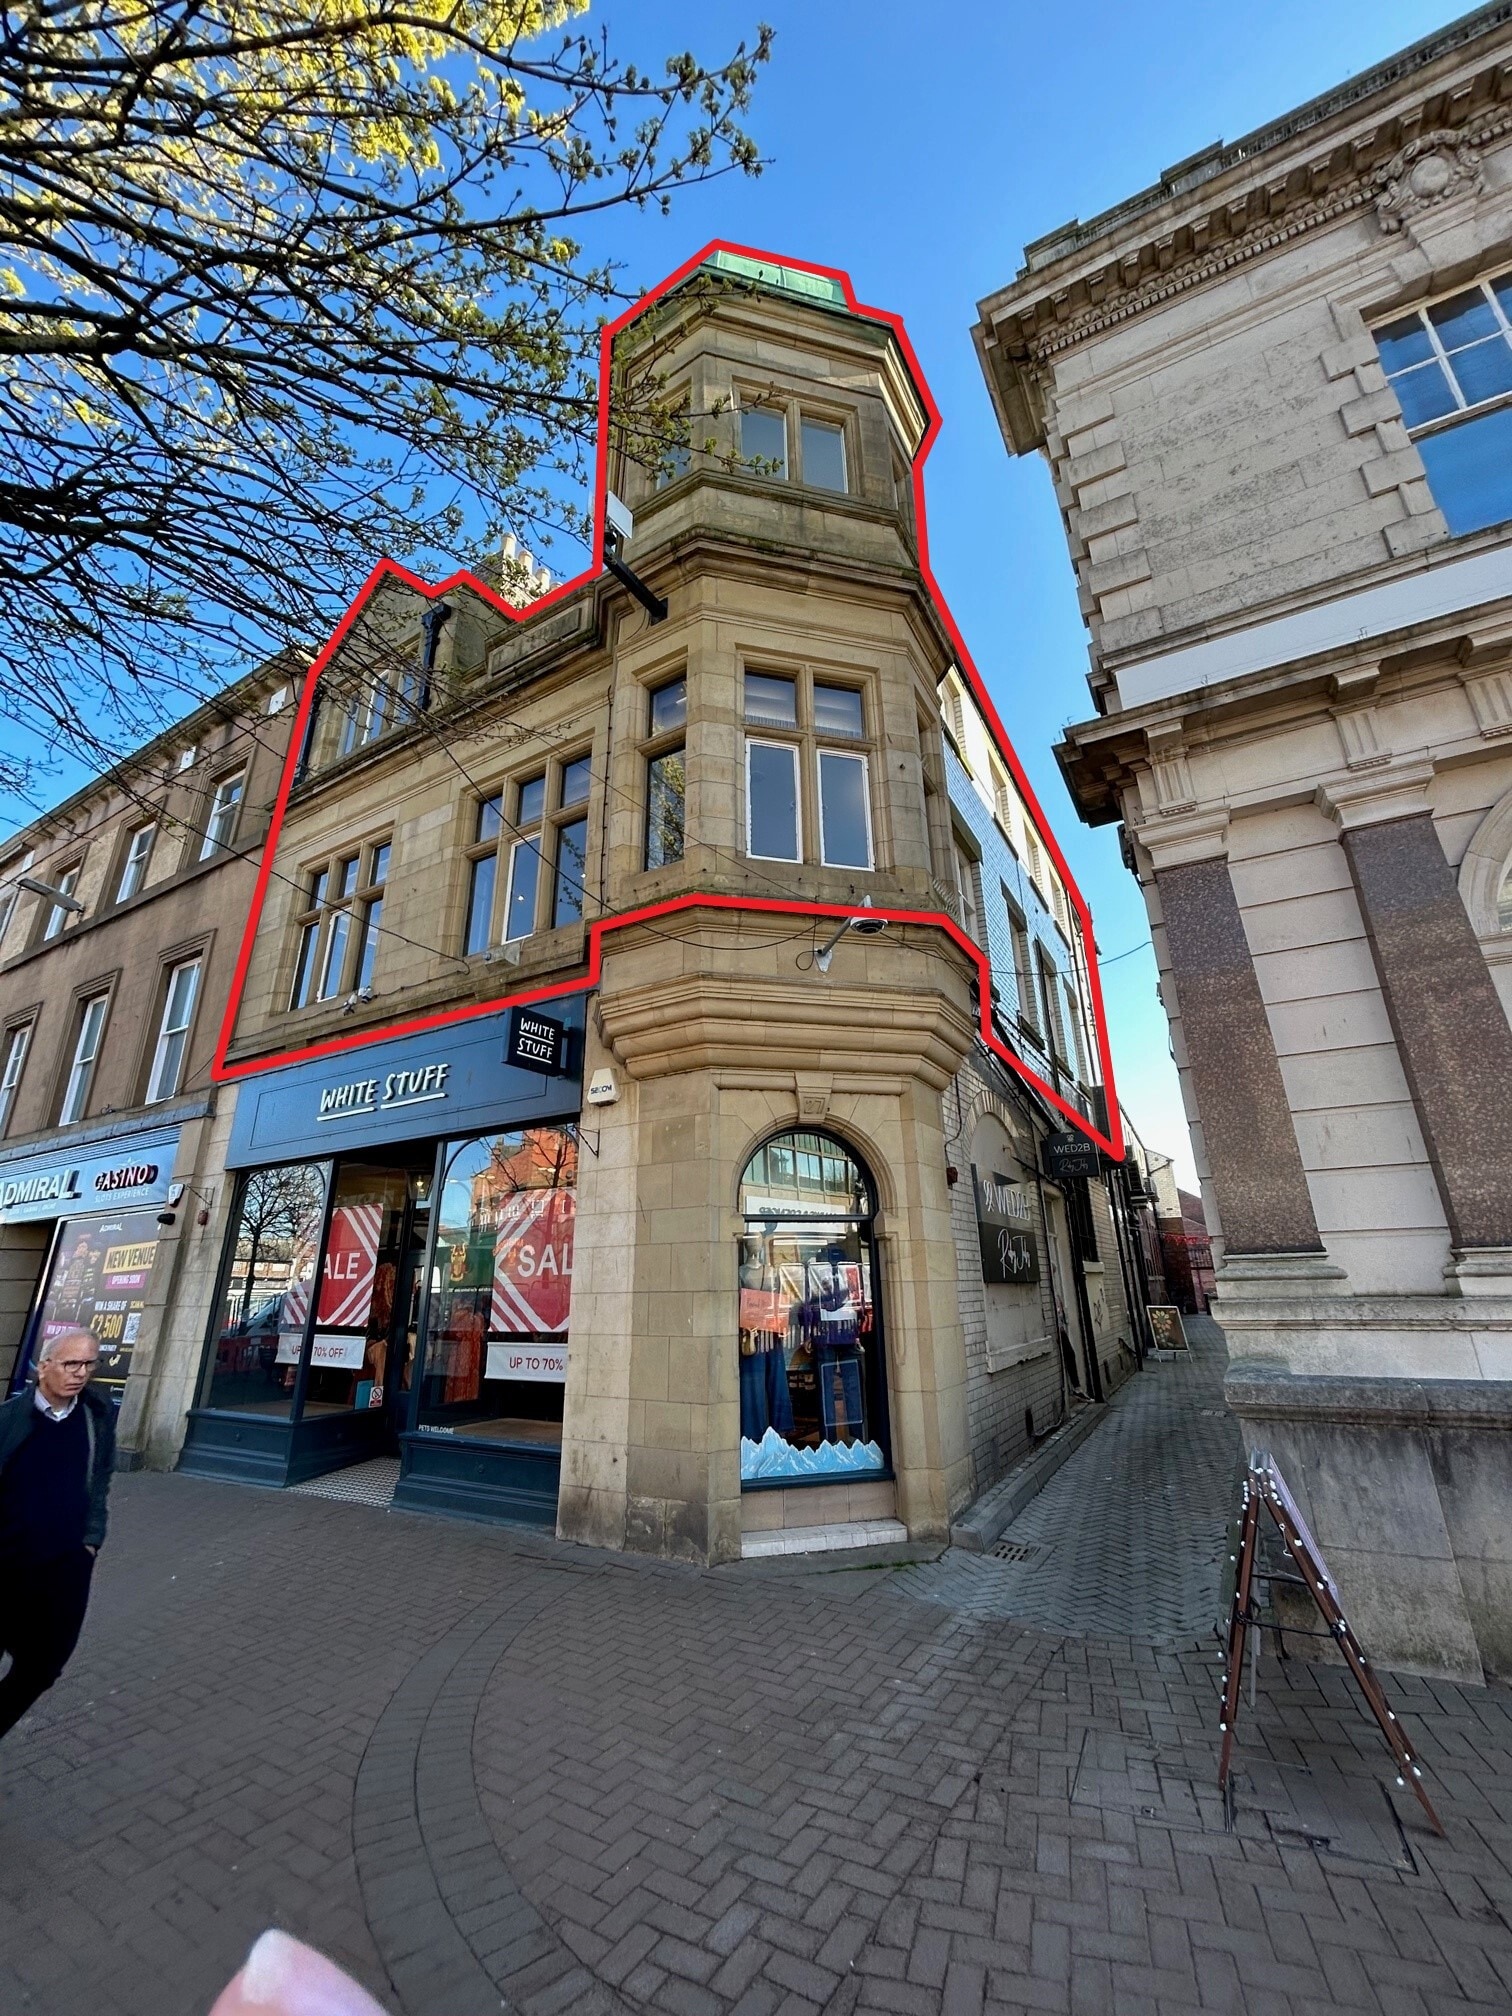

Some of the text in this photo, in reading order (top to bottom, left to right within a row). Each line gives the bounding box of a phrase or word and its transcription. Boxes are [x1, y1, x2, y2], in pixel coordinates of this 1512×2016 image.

[520, 1017, 555, 1040] WHITE
[517, 1037, 553, 1059] STUFF
[320, 1063, 450, 1113] WHITE STUFF
[1053, 1142, 1090, 1154] WED2B
[95, 1164, 157, 1191] CASINO
[106, 1245, 156, 1270] NEW VENUE
[323, 1252, 361, 1280] ALE
[517, 1242, 572, 1278] SAL
[313, 1346, 327, 1358] 70%
[328, 1348, 345, 1359] OFF
[509, 1357, 564, 1371] UP TO 70%
[418, 1424, 430, 1432] PETS
